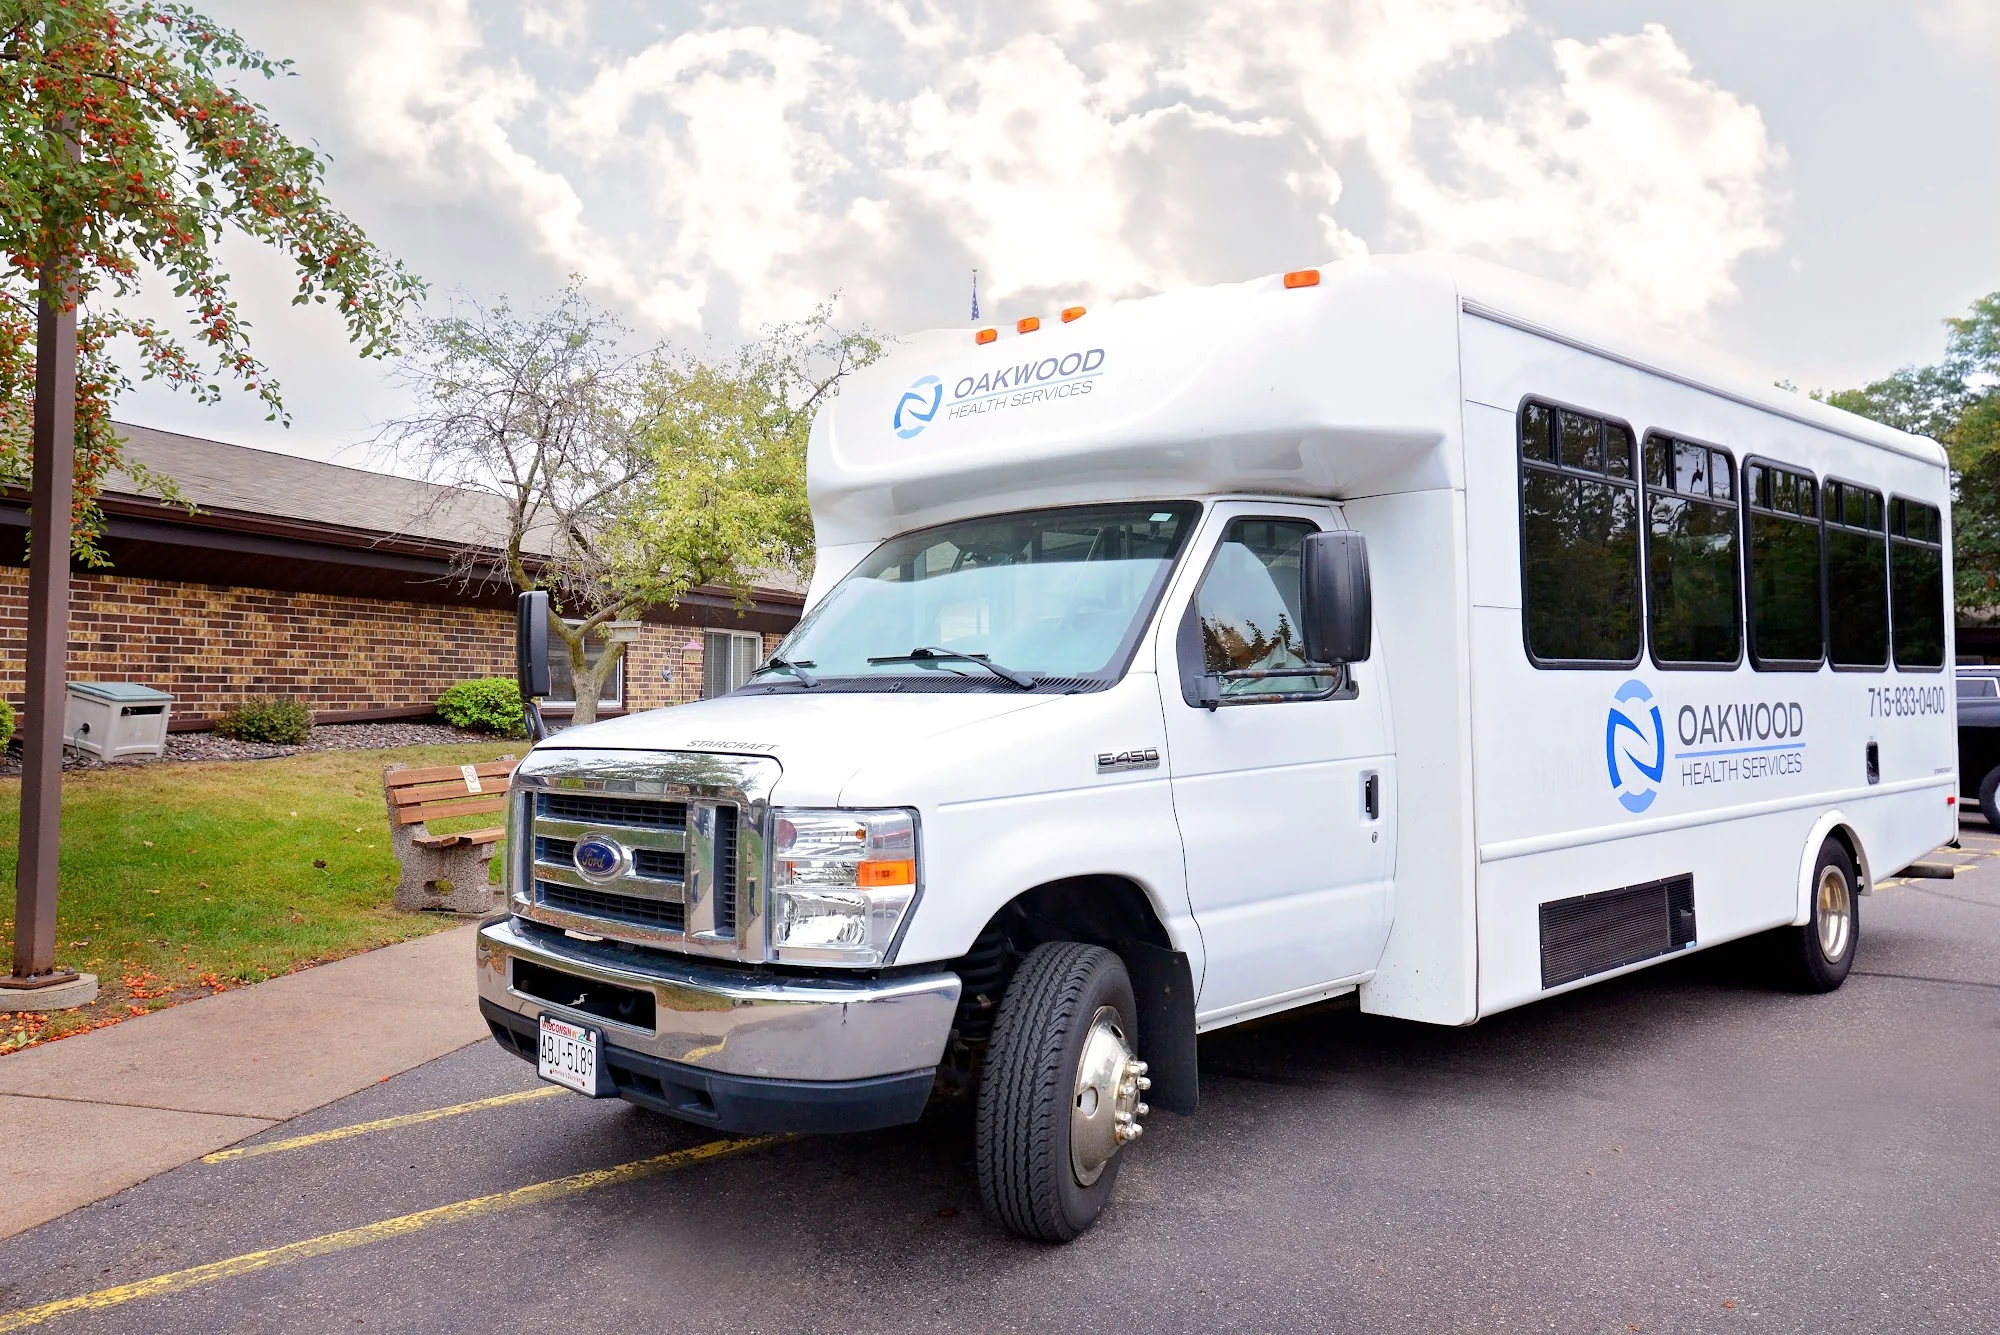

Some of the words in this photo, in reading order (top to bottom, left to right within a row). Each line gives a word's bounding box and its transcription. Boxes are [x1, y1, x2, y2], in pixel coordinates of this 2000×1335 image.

[954, 348, 1105, 398] OAKWOOD
[948, 398, 1007, 421] HEALTH
[1011, 380, 1093, 408] SERVICES
[1868, 686, 1945, 717] 715-833-0400
[1678, 702, 1804, 746] OAKWOOD
[686, 740, 780, 751] STARCRAFT
[1682, 758, 1739, 787] HEALTH
[1742, 752, 1803, 780] SERVICES
[582, 847, 606, 868] Ford
[541, 1034, 594, 1077] ABJ-5189
